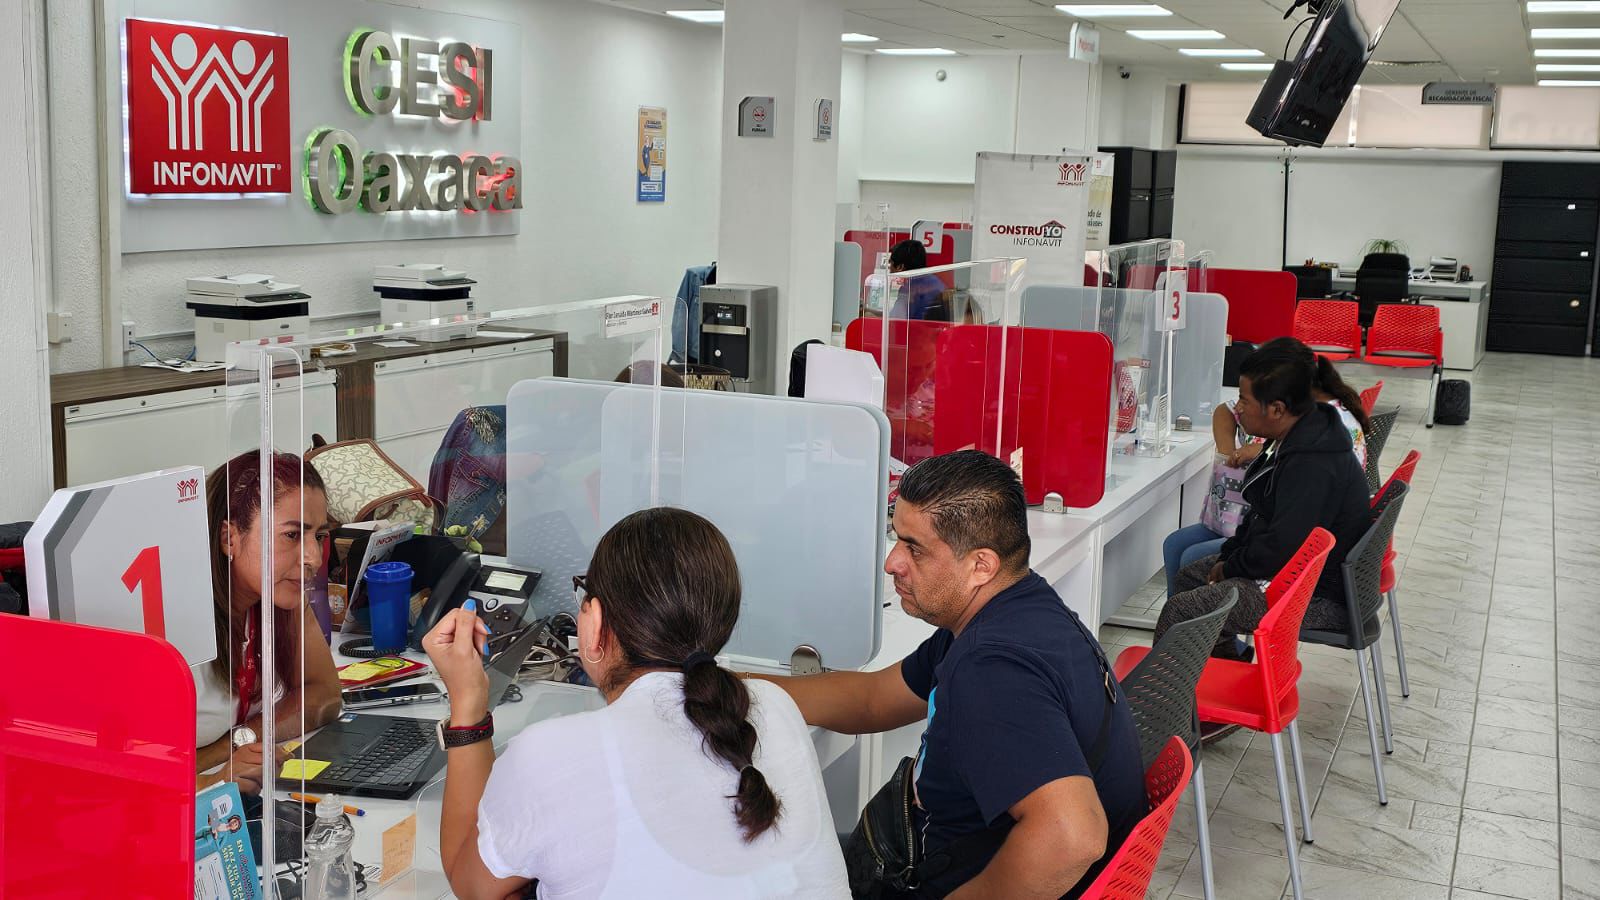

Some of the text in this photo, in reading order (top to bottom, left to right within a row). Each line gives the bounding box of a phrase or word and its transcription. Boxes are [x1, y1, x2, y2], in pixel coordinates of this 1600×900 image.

[349, 30, 492, 121] CESI
[153, 160, 275, 187] INFONAVIT
[306, 128, 522, 215] Oaxaca
[923, 231, 934, 248] 5
[990, 224, 1062, 238] CONSTRUYO
[1013, 237, 1062, 247] INFONAVIT
[1172, 290, 1181, 321] 3
[121, 545, 166, 639] 1
